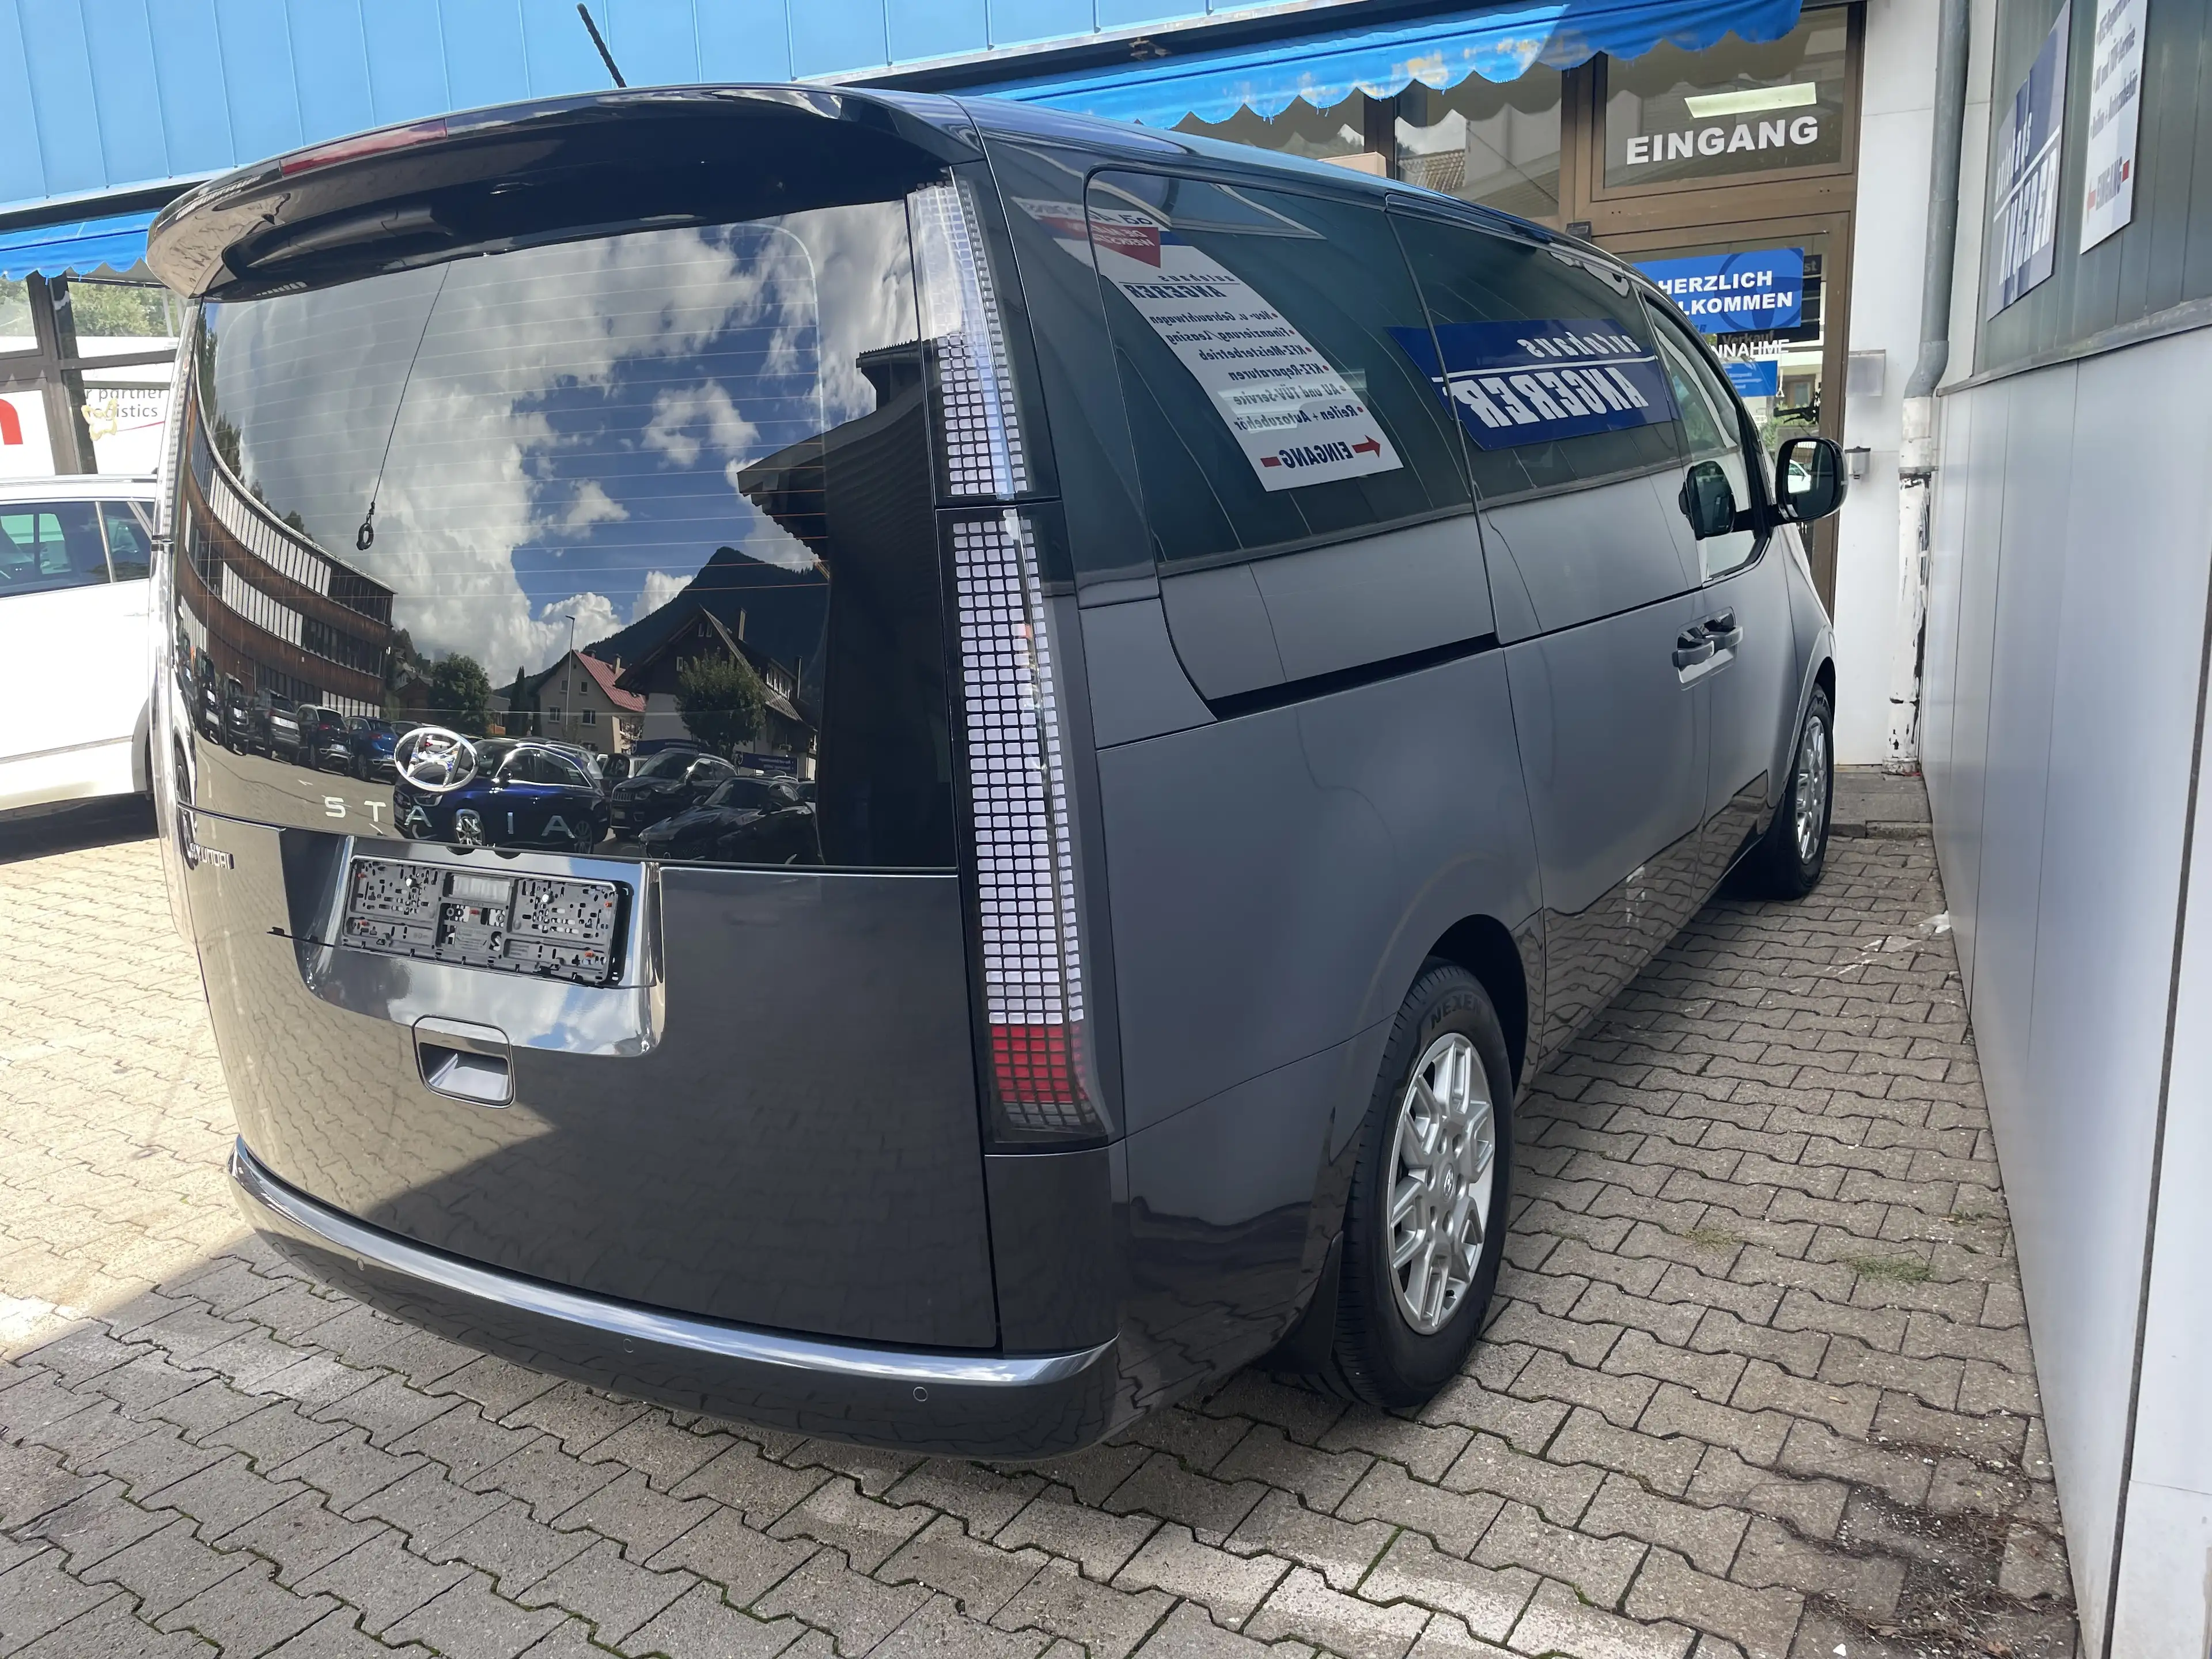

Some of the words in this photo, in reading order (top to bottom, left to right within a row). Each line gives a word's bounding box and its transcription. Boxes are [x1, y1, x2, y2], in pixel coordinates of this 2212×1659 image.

[1627, 116, 1819, 165] EINGANG
[1658, 270, 1772, 296] HERZLICH
[1677, 291, 1793, 316] LKOMMEN
[1710, 339, 1790, 358] NNAHME
[99, 389, 162, 402] partner
[324, 796, 575, 840] STARIA
[1430, 994, 1479, 1030] NEXEN
